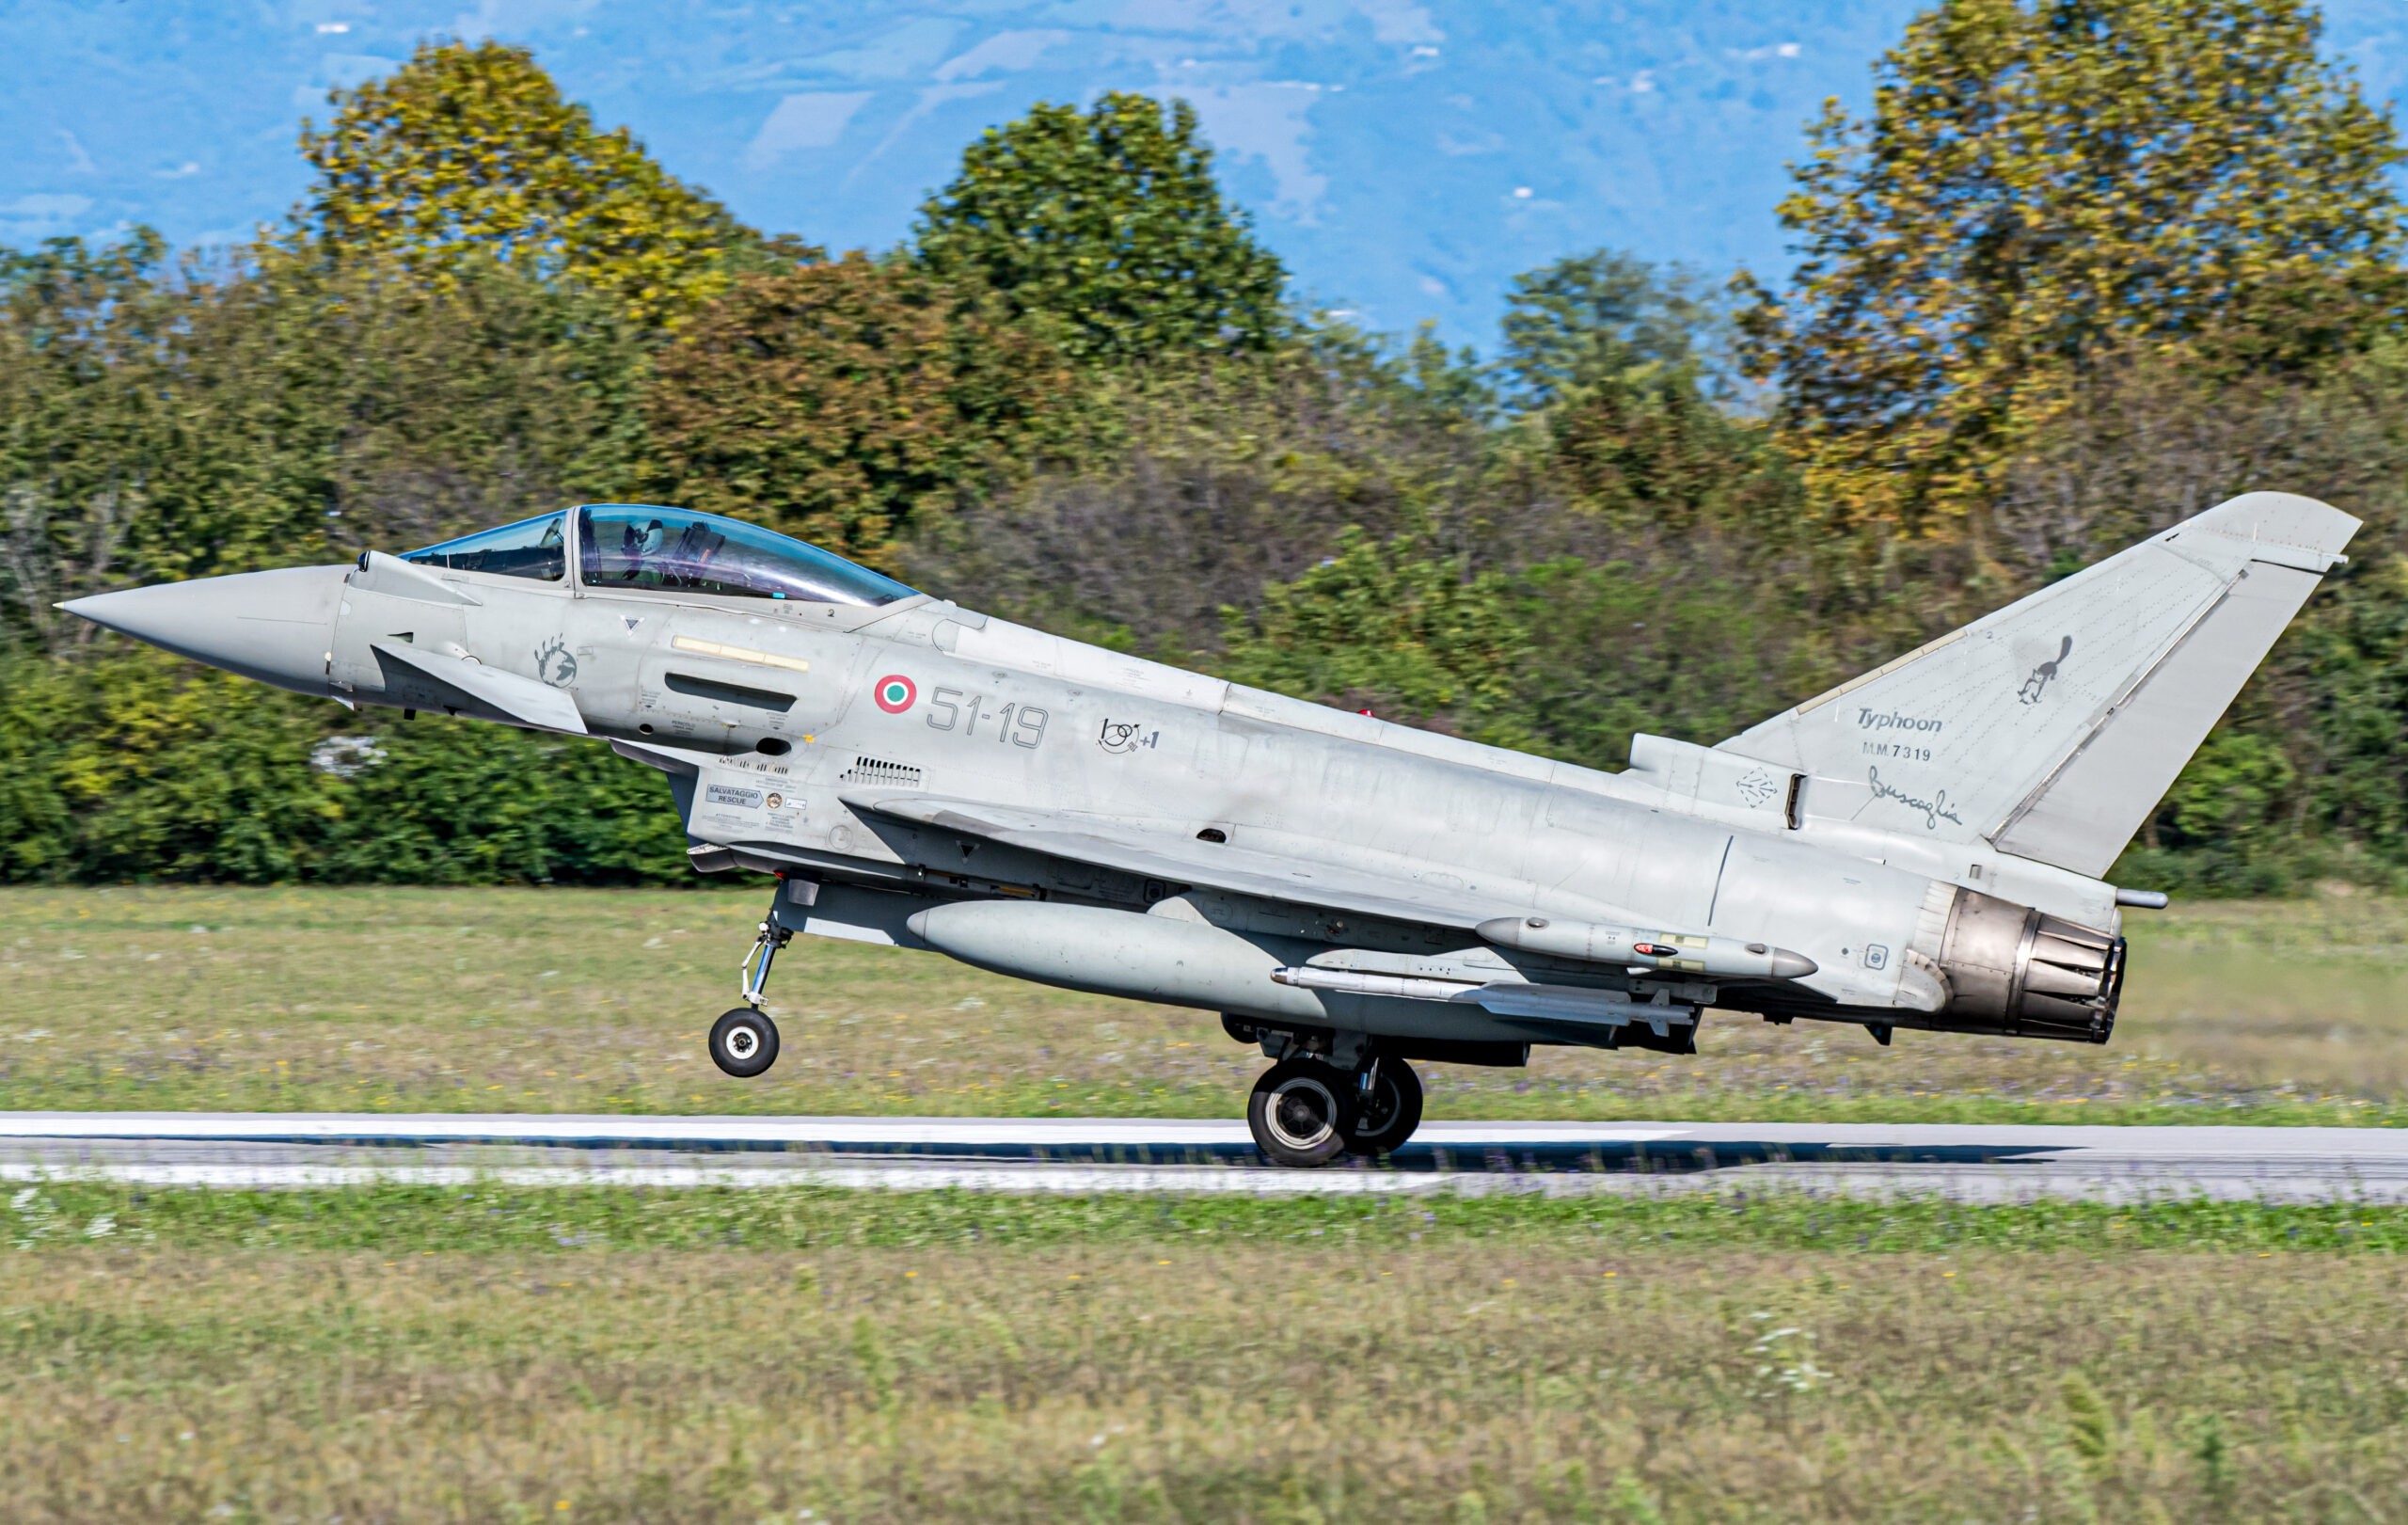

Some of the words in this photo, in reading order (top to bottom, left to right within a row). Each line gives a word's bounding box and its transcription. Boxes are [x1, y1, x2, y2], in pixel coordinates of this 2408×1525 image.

[927, 687, 1049, 749] 51-19
[1858, 708, 1942, 732] Typhoon
[1893, 745, 1931, 761] 7319
[709, 786, 758, 800] SALVATAGGIO
[718, 796, 746, 804] RESCUE
